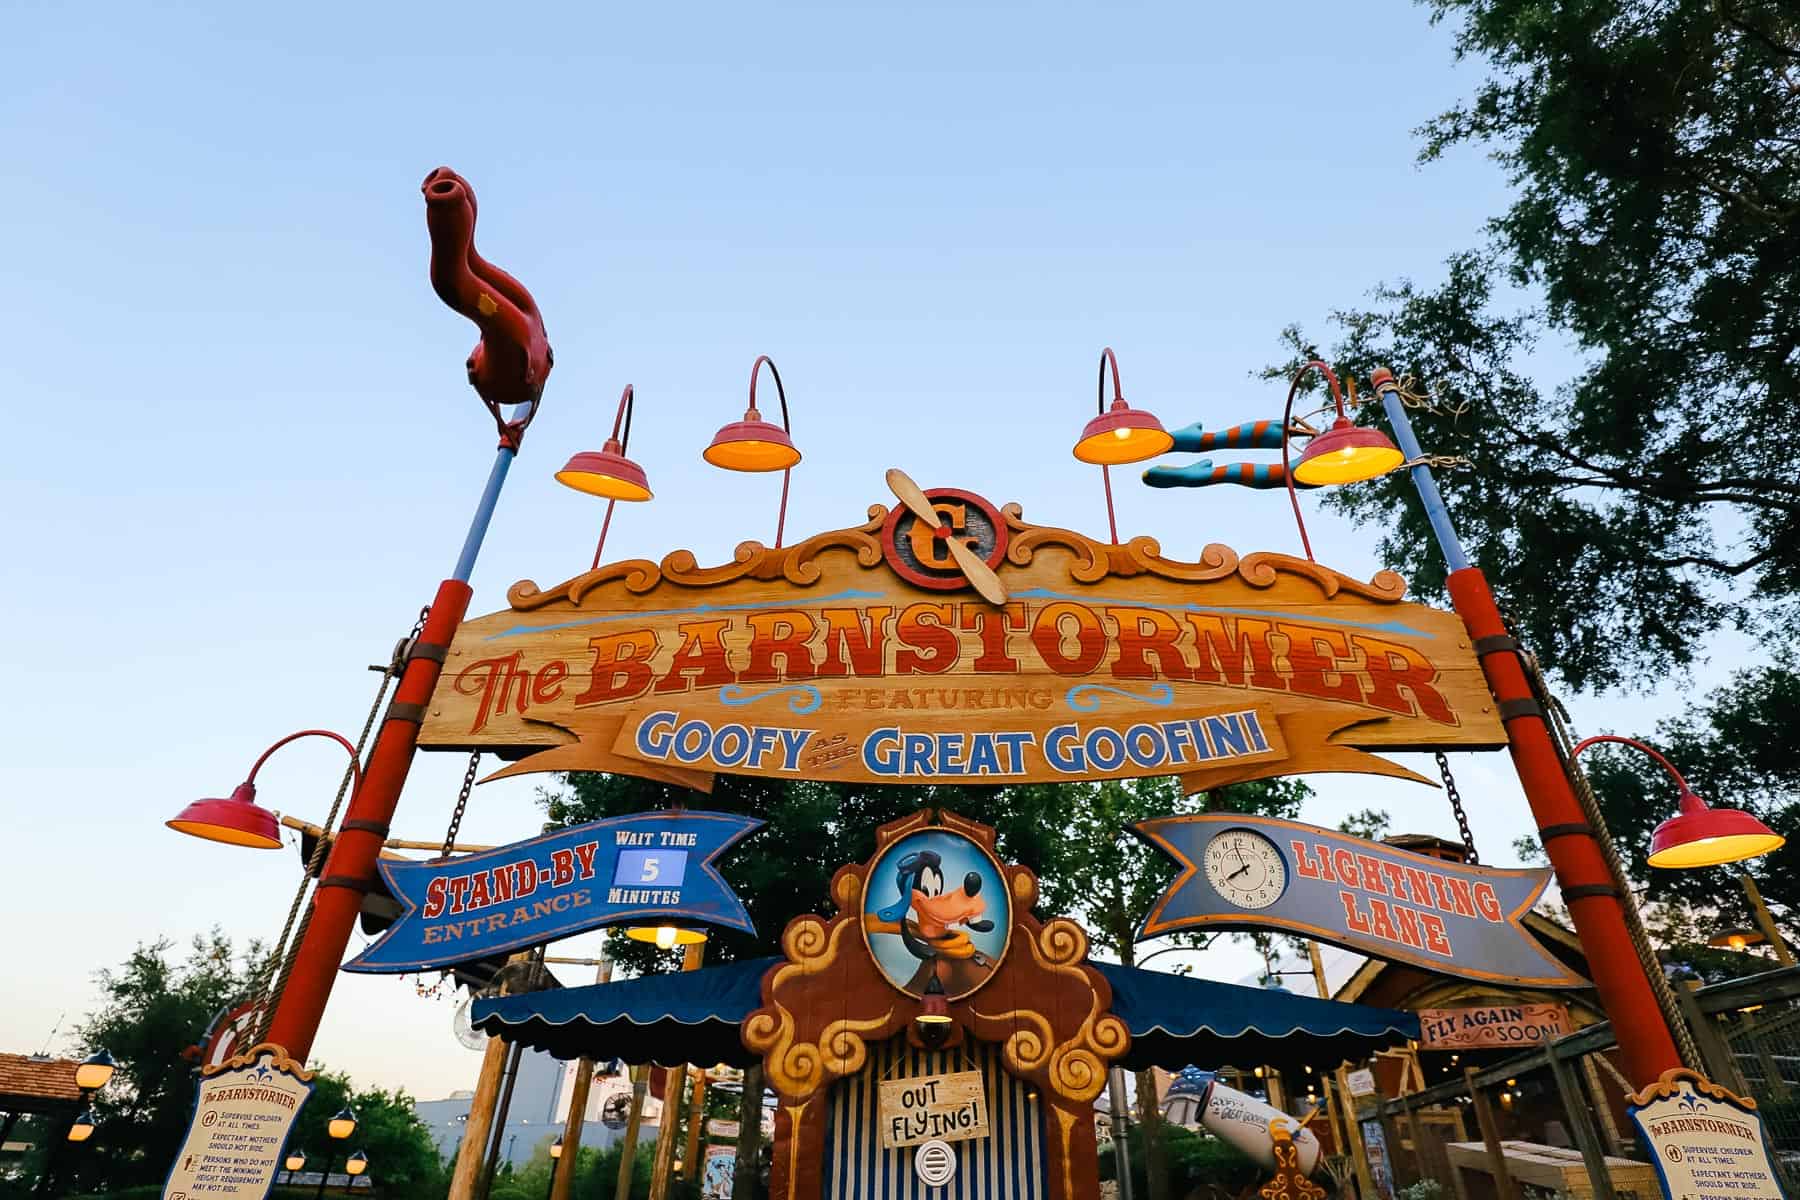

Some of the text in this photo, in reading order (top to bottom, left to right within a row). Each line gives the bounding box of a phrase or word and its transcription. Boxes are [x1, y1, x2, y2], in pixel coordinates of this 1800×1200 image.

[906, 503, 979, 569] G
[453, 602, 1460, 735] The BARNSTORMER
[837, 688, 1054, 710] FEATURING
[635, 710, 816, 771] GOOFY
[811, 735, 848, 752] AS
[862, 726, 1037, 777] GREAT
[1043, 709, 1273, 774] GOOFINI
[615, 831, 697, 846] WAIT TIME
[1222, 841, 1229, 849] 11
[1212, 851, 1221, 860] 10
[640, 857, 659, 882] 5
[1211, 864, 1218, 873] 9
[1268, 865, 1275, 873] 3
[423, 841, 599, 919] STAND-BY
[1219, 879, 1225, 887] 8
[1266, 880, 1274, 888] 4
[1290, 839, 1504, 923] LIGHTNING
[607, 888, 681, 905] MINUTES
[1245, 893, 1252, 902] 6
[1260, 890, 1267, 899] 5
[422, 888, 592, 945] ENTRANCE
[1339, 890, 1453, 957] LANE
[1427, 1008, 1523, 1042] FLY AGAIN
[216, 1087, 296, 1110] BARNSTORMER
[902, 1080, 940, 1108] OUT
[220, 1111, 283, 1122] SUPERVISE CHILDREN
[892, 1101, 978, 1141] FLYING!
[217, 1120, 226, 1128] AT
[1662, 1118, 1756, 1143] BARNSTORMER
[212, 1133, 248, 1141] EXPECTANT
[208, 1142, 234, 1150] SHOULD
[1682, 1145, 1754, 1156] SUPERVISE CHILDREN
[203, 1156, 231, 1164] PERSONS
[233, 1167, 262, 1175] MINIMUM
[1690, 1169, 1768, 1180] EXPECTANT MOTHERS
[220, 1176, 265, 1184] REQUIREMENT
[1695, 1180, 1724, 1188] SHOULD
[1724, 1181, 1740, 1189] NOT
